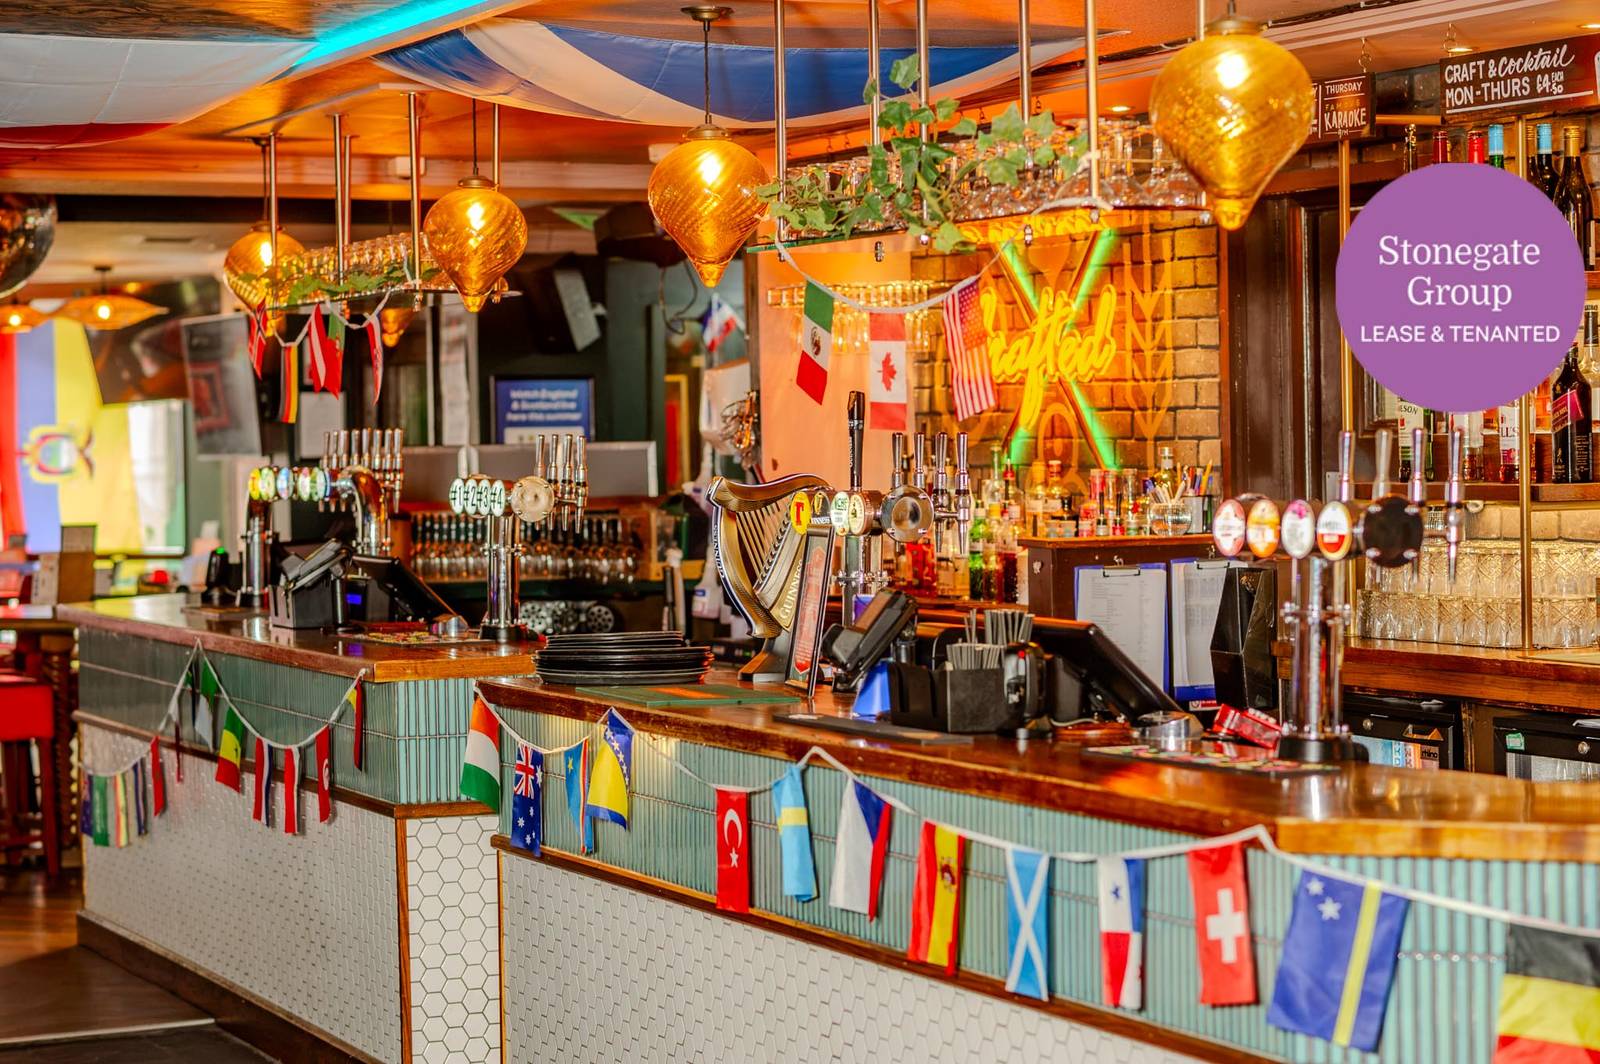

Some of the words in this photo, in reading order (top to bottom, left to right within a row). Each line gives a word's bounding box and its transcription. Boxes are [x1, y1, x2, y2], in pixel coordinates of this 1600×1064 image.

[1444, 60, 1485, 84] CRAFT
[1488, 59, 1497, 79] &
[1498, 44, 1575, 78] Cocktail
[1325, 81, 1363, 95] THURSDAY
[1324, 107, 1366, 131] KARAOKE
[451, 485, 462, 507] #1
[464, 485, 476, 507] #2
[477, 486, 489, 508] #3
[490, 486, 503, 509] #4
